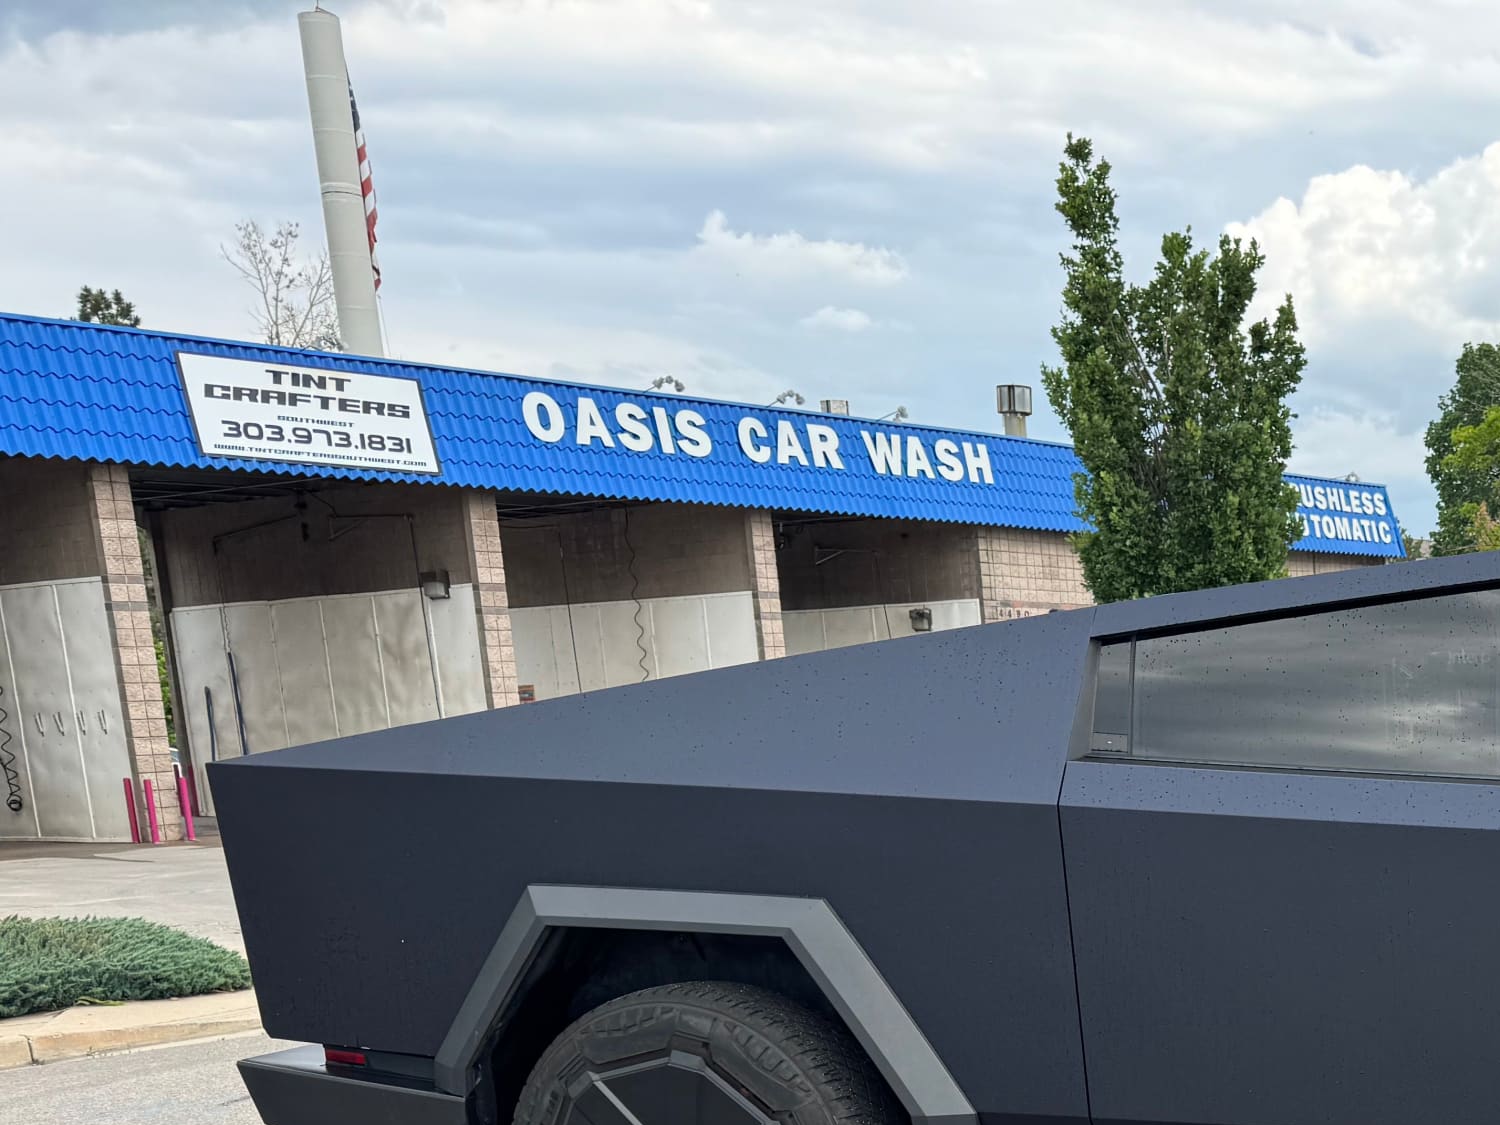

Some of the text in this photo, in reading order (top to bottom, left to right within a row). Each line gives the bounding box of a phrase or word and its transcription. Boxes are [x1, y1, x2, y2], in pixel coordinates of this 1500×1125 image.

[265, 369, 351, 392] TINT
[204, 383, 410, 419] CRAFTERS
[221, 419, 412, 454] 303.973.1831
[277, 415, 355, 428] SOUTHWEST
[522, 391, 995, 485] OASIS CAR WASH
[1280, 482, 1387, 516] USHLESS
[1286, 511, 1392, 544] UTOMATIC
